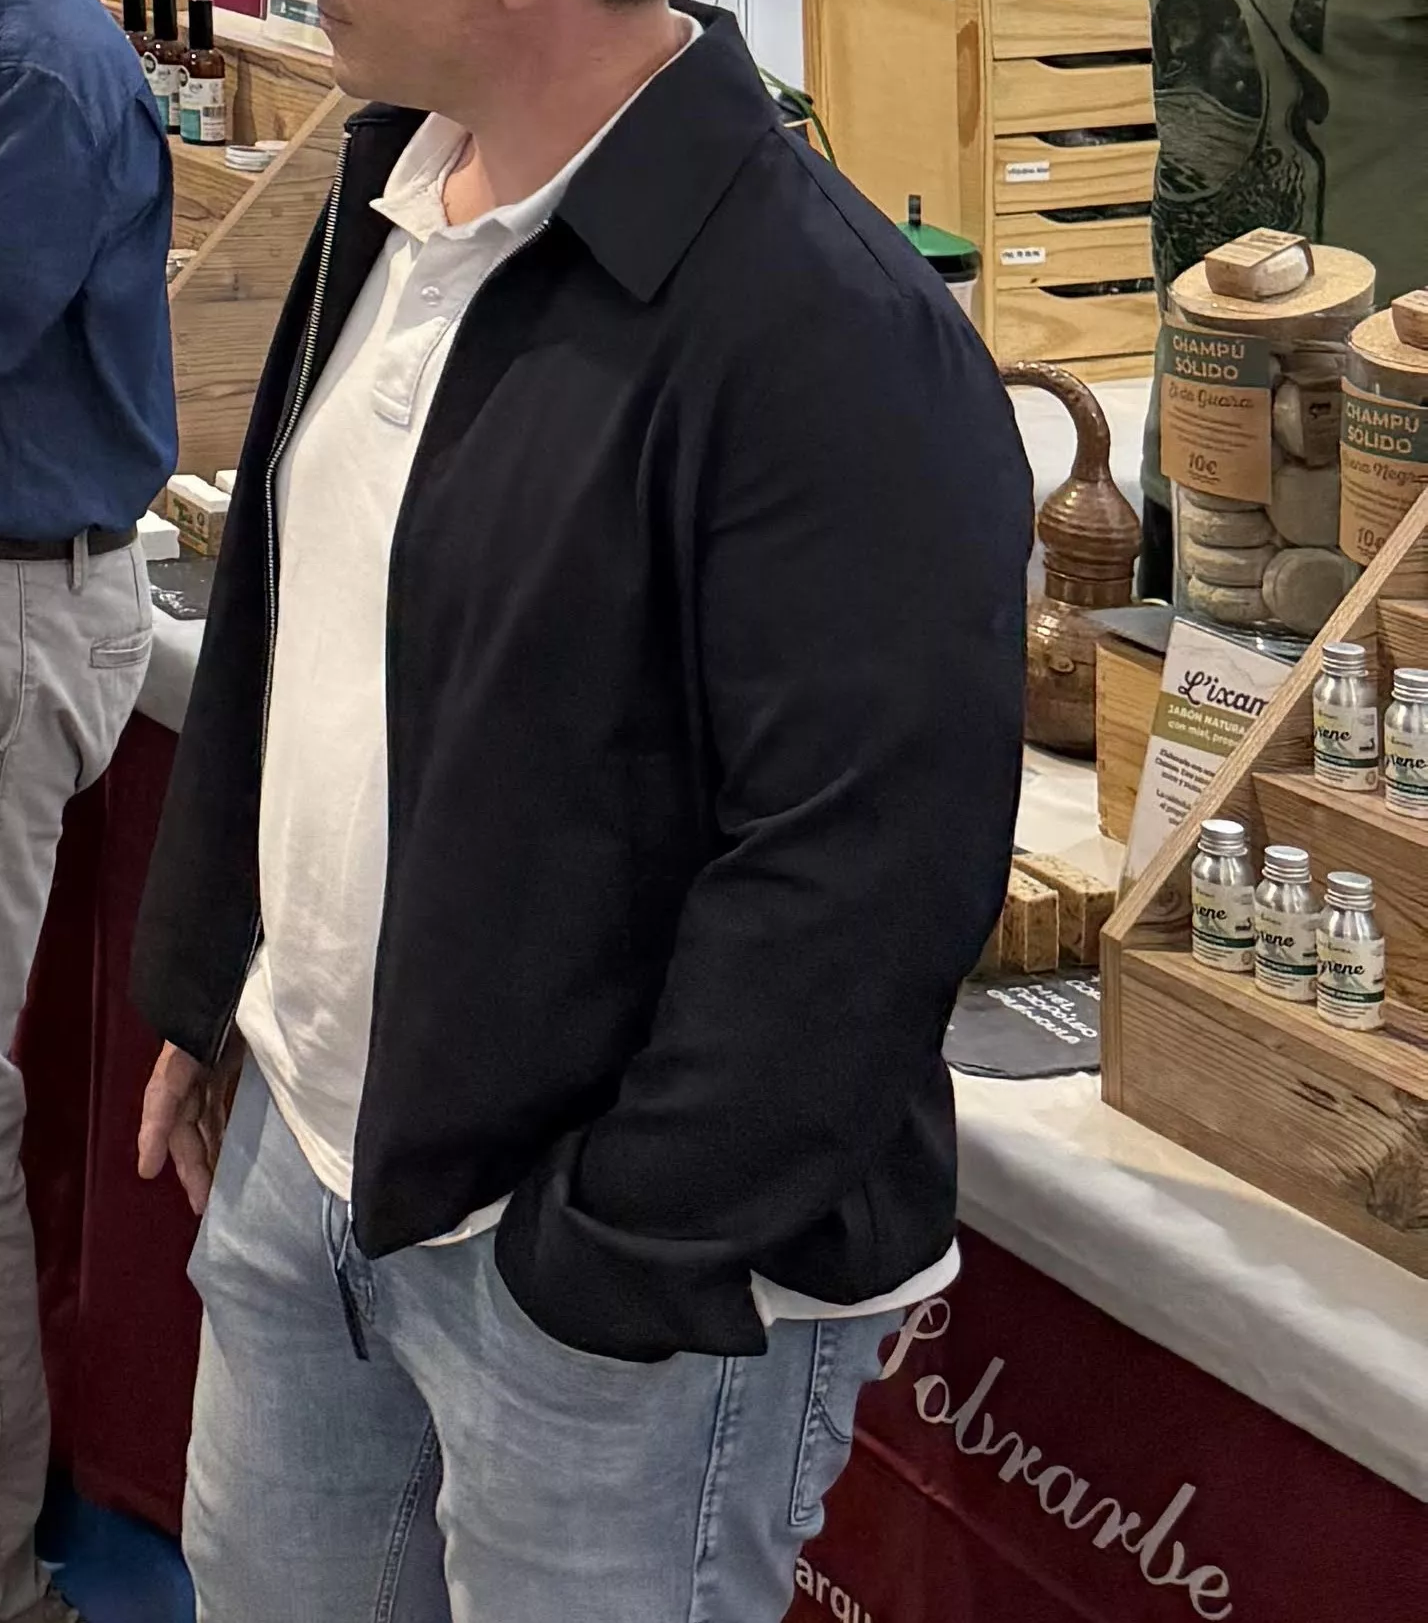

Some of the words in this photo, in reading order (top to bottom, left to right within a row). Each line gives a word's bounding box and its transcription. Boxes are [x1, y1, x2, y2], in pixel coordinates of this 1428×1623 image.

[1172, 335, 1245, 360] CHAMPÚ
[1175, 356, 1239, 380] SÓLIDO
[1346, 402, 1420, 434] CHAMPÚ
[1347, 423, 1412, 454] SÓLIDO
[1188, 452, 1218, 476] 10€
[1204, 715, 1245, 736] NATURA
[879, 1296, 1234, 1621] Sobrarbe
